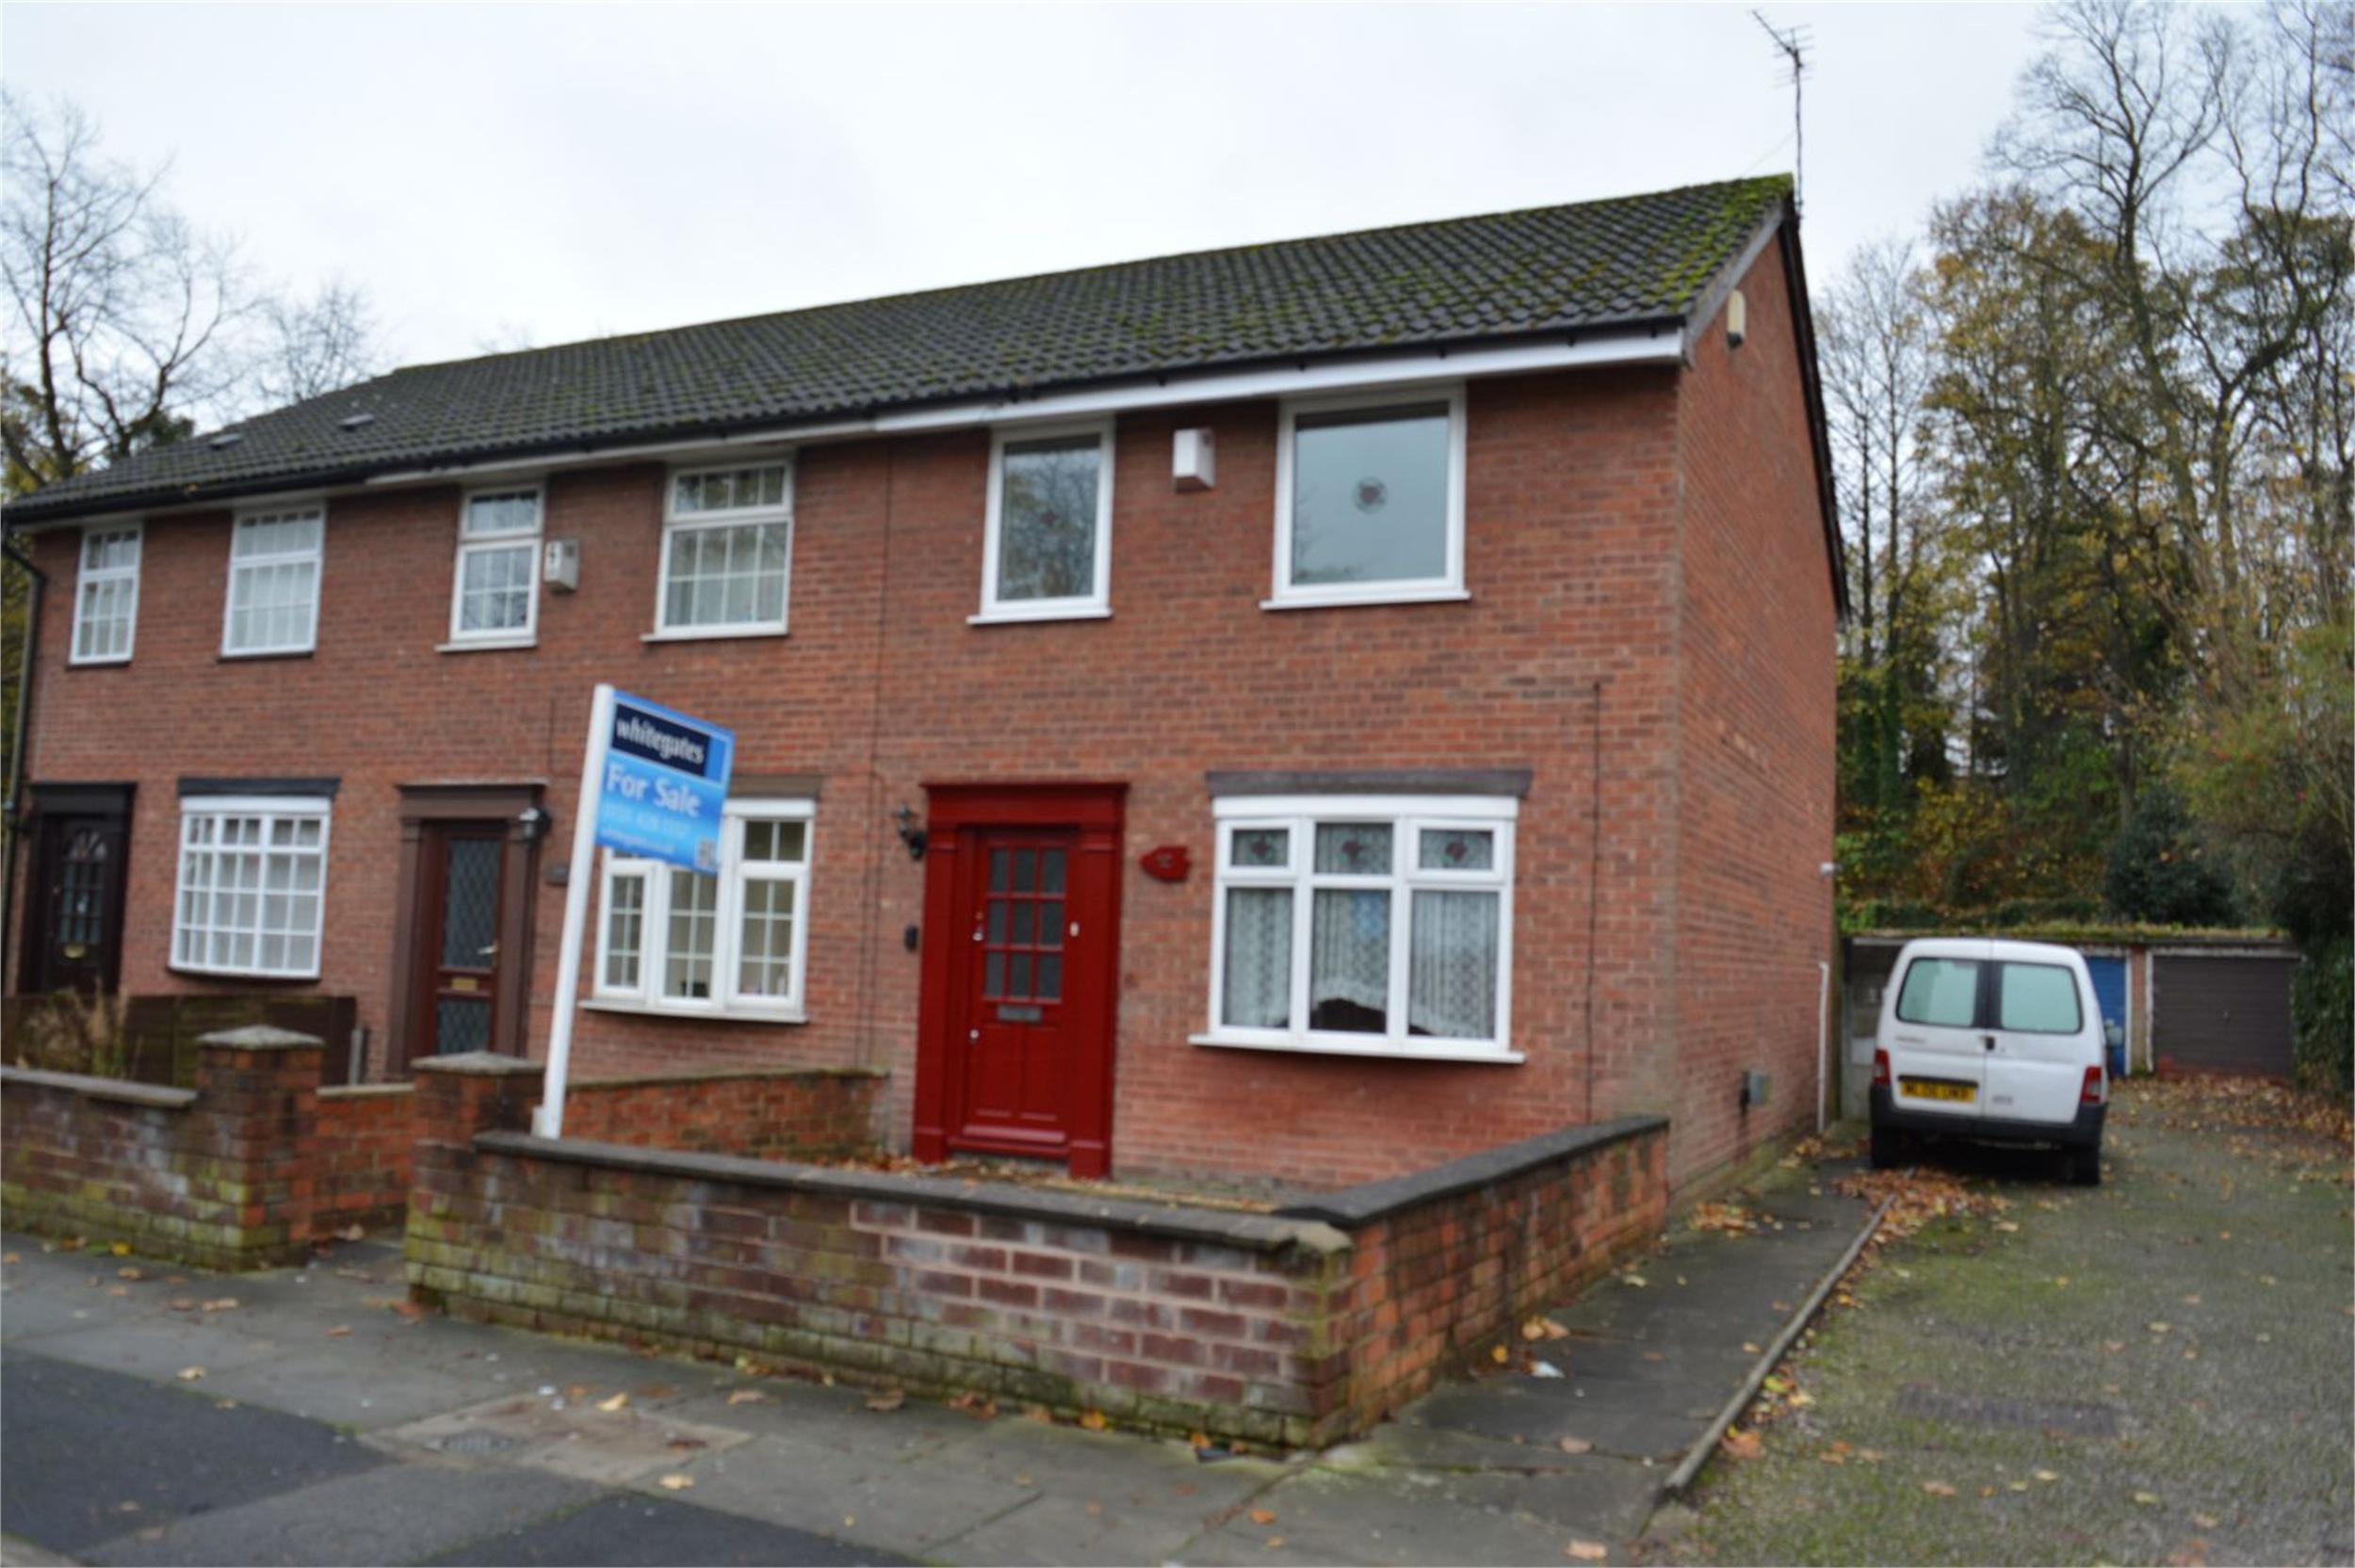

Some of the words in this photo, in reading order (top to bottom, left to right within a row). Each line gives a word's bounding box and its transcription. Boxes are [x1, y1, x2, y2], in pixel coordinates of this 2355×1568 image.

[616, 718, 704, 764] whitegates
[606, 764, 648, 800] For
[654, 776, 701, 818] Sale
